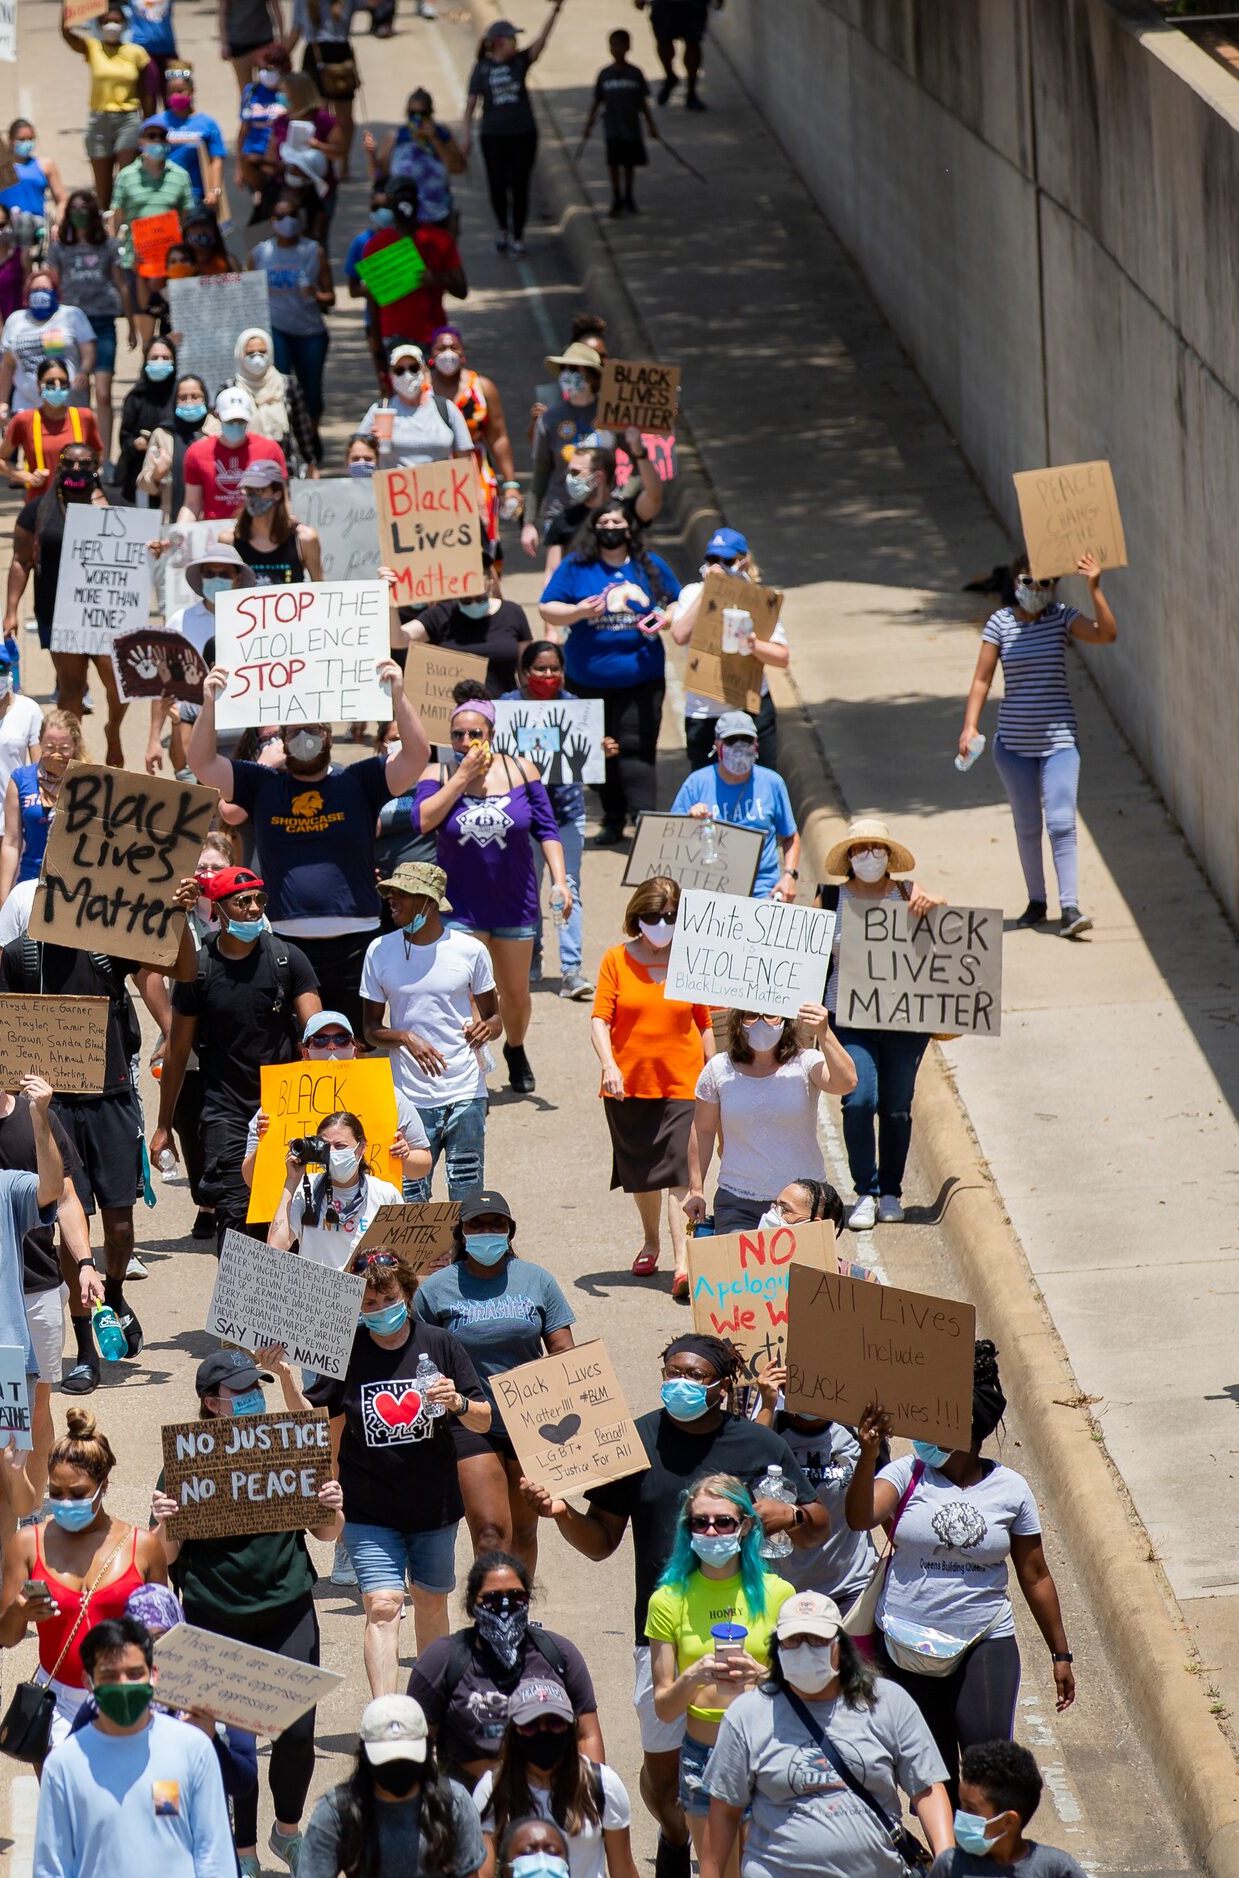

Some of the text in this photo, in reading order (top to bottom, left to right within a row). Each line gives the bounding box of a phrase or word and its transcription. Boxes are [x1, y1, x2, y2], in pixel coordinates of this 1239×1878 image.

[614, 363, 672, 388] BLACK
[618, 384, 670, 405] LIVES
[603, 405, 672, 429] MATTER
[387, 468, 474, 517] Black
[1035, 467, 1096, 509] PEACE
[97, 507, 127, 538] IS
[391, 524, 472, 553] Lives
[71, 539, 146, 564] HER LIFE
[85, 570, 128, 586] WORTH
[391, 562, 479, 601] Matter
[74, 587, 140, 607] MORE THAN
[236, 590, 381, 639] STOP THE
[82, 607, 126, 629] MINE?
[239, 626, 371, 662] VIOLENCE
[230, 658, 375, 699] STOP THE
[259, 689, 361, 722] HATE
[65, 773, 215, 847] Black
[271, 811, 345, 827] SHOWCASE
[285, 821, 329, 834] CAMP
[73, 831, 175, 883] Lives
[43, 873, 187, 939] Matter
[681, 896, 833, 957] White SILENCE
[864, 905, 989, 952] BLACK
[686, 945, 802, 991] VIOLENCE
[866, 950, 982, 987] LIVES
[0, 1001, 30, 1013] Floyd,
[32, 1002, 55, 1012] Eric
[848, 987, 995, 1032] MATTER
[277, 1074, 347, 1117] BLACK
[375, 1204, 426, 1223] BLACK
[738, 1227, 797, 1269] NO
[310, 1284, 341, 1300] PHILLIP
[810, 1275, 960, 1337] All Lives
[240, 1302, 272, 1322] JORDAN
[285, 1307, 316, 1326] TAYLOR
[450, 1294, 536, 1334] THRASHER
[709, 1305, 755, 1335] We
[214, 1318, 340, 1374] SAY NAMES
[861, 1327, 926, 1366] Include
[498, 1360, 602, 1409] Black Lives
[787, 1363, 848, 1403] BLACK
[176, 1421, 329, 1461] NO JUSTICE
[535, 1443, 583, 1469] LGBT+
[181, 1468, 318, 1506] NO PEACE
[920, 1558, 965, 1574] Queens Building
[709, 1608, 743, 1620] HONEY
